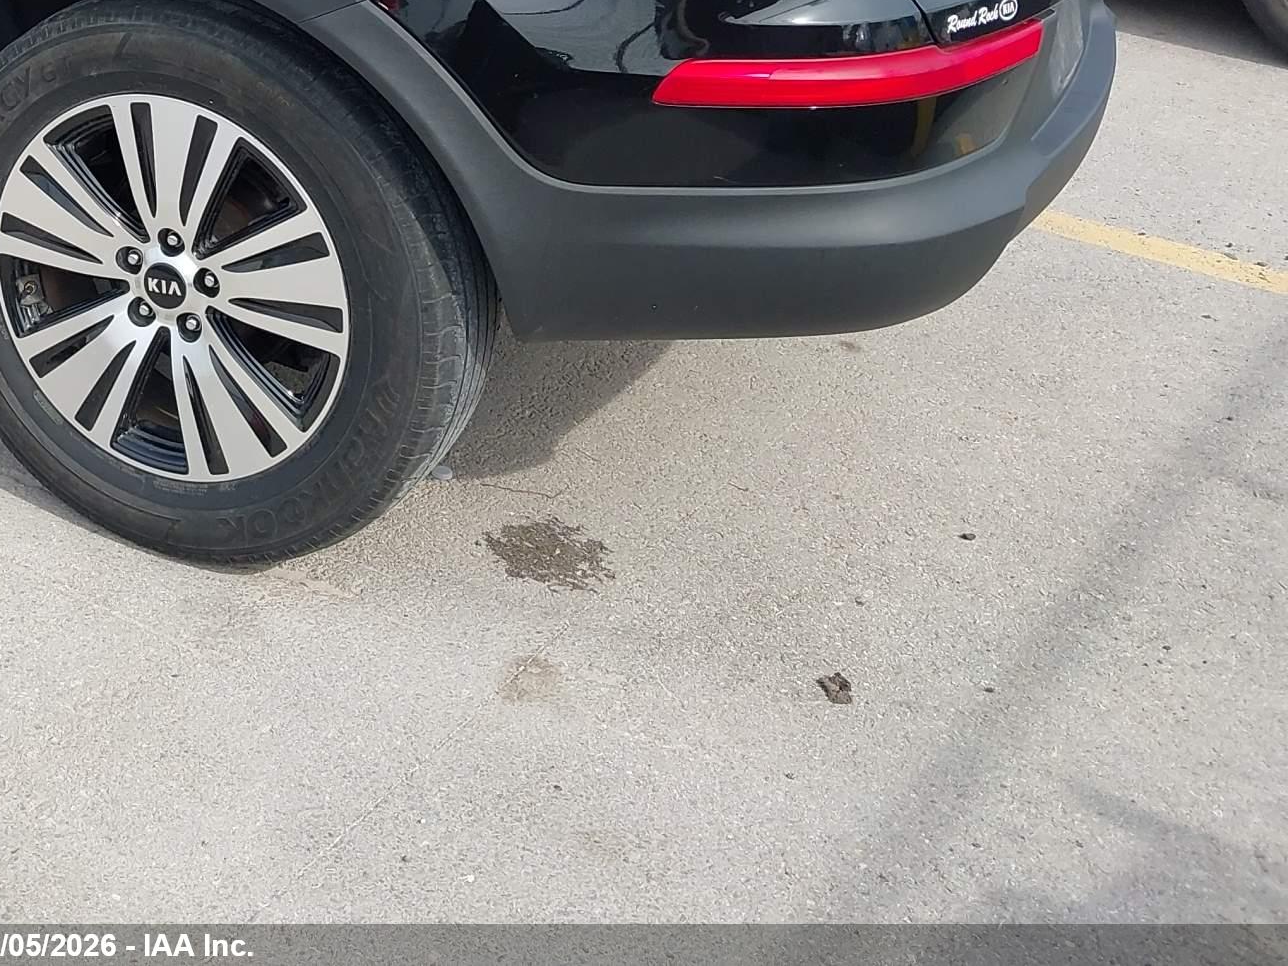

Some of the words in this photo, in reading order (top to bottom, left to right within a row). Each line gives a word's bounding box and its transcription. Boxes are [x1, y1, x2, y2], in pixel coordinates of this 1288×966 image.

[947, 10, 978, 34] Round
[978, 3, 999, 25] Rock
[148, 277, 182, 296] KIA
